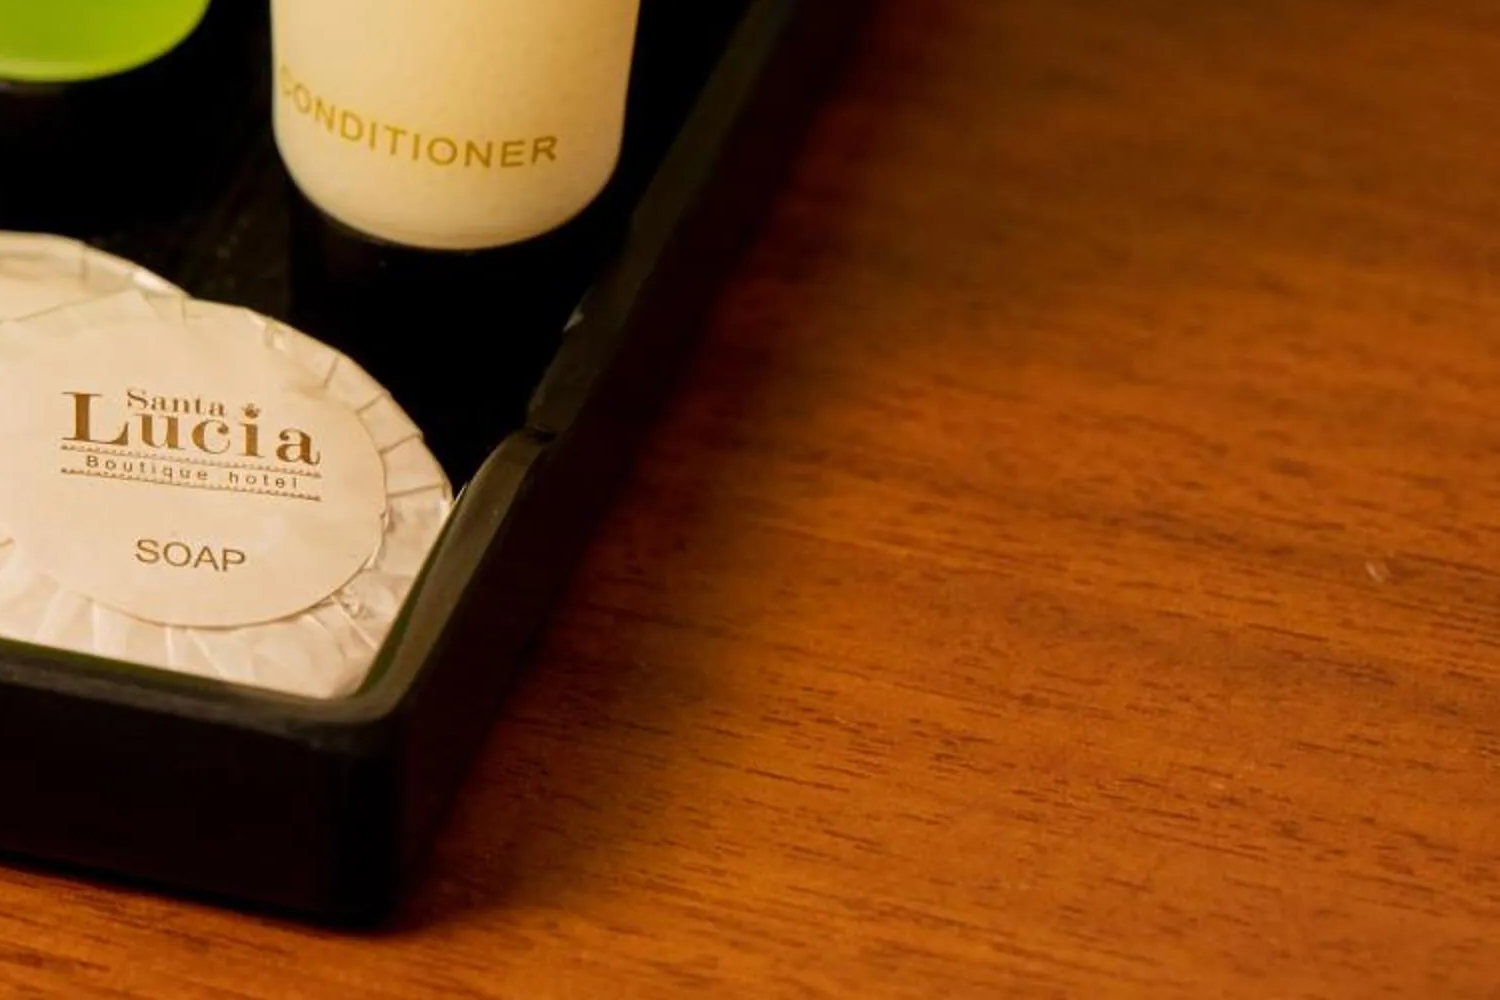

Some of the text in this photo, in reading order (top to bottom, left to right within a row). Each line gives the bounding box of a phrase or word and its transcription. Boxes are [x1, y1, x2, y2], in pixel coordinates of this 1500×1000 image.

[279, 64, 559, 169] CONDITIONER
[126, 388, 227, 417] Santa
[60, 391, 322, 466] Lucia
[86, 455, 299, 489] Boutique hotel
[135, 539, 246, 573] SOAP
